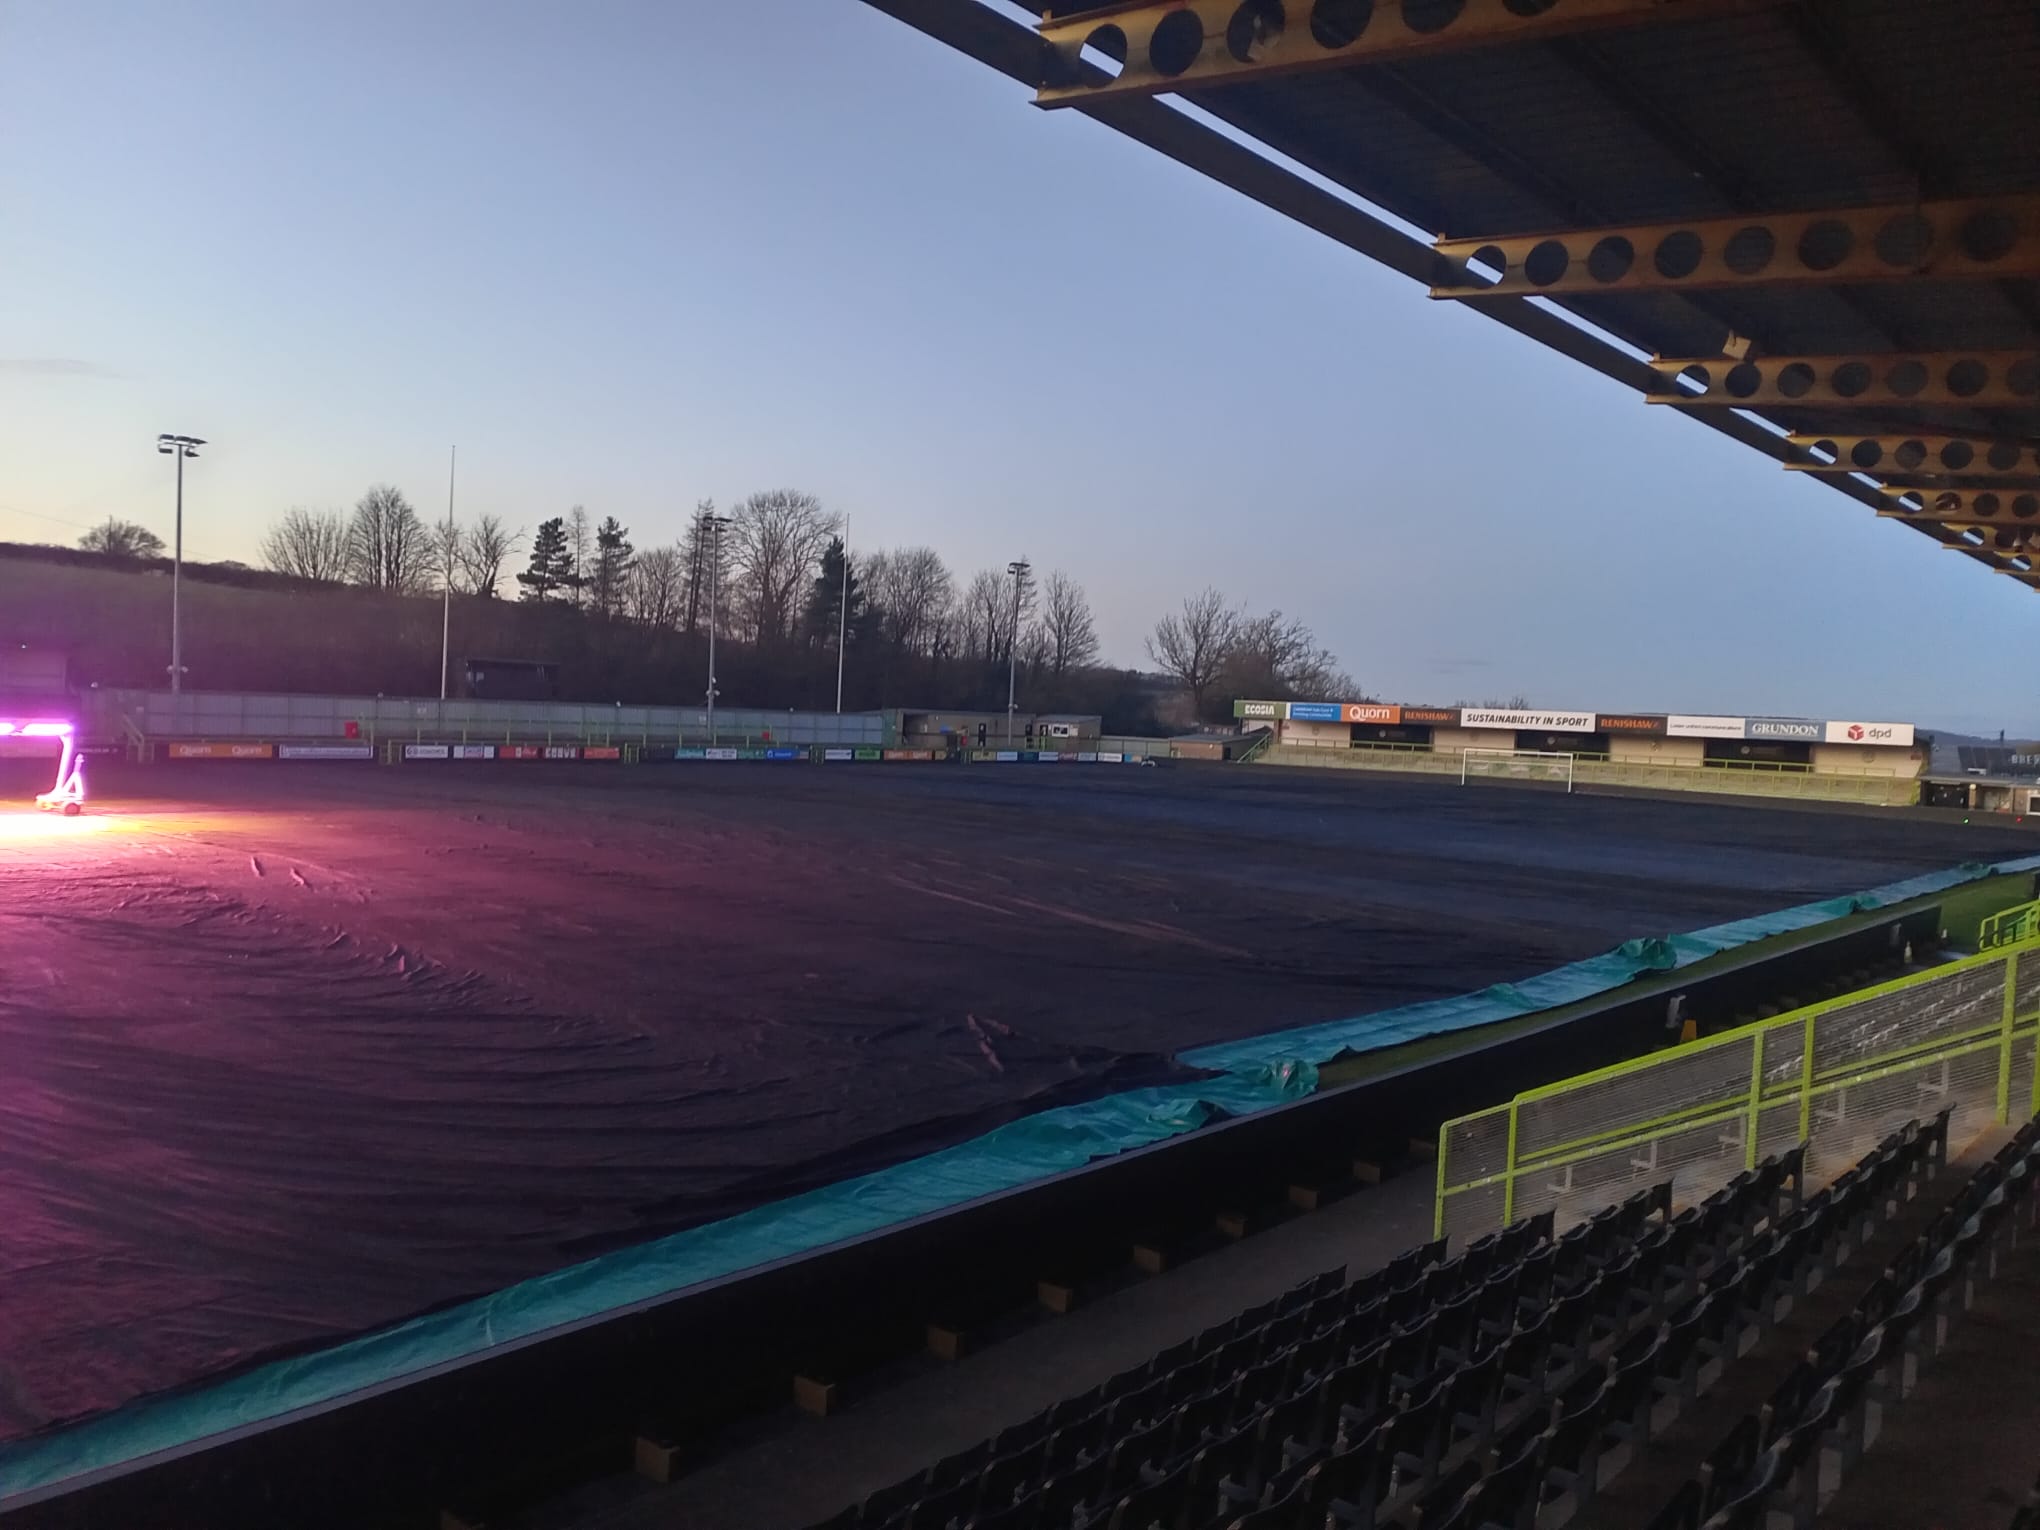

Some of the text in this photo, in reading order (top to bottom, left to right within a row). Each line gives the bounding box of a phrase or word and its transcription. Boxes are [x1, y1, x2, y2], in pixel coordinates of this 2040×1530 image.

[1244, 703, 1275, 716] ECOSIA
[1349, 706, 1390, 723] Quorn
[1404, 711, 1448, 722] RENISHAW
[1466, 712, 1589, 727] SUSTAINABILITY IN SPORT
[1600, 718, 1653, 729] RENISHAW
[1751, 722, 1820, 738] GRUNDON
[1868, 727, 1892, 741] dpd
